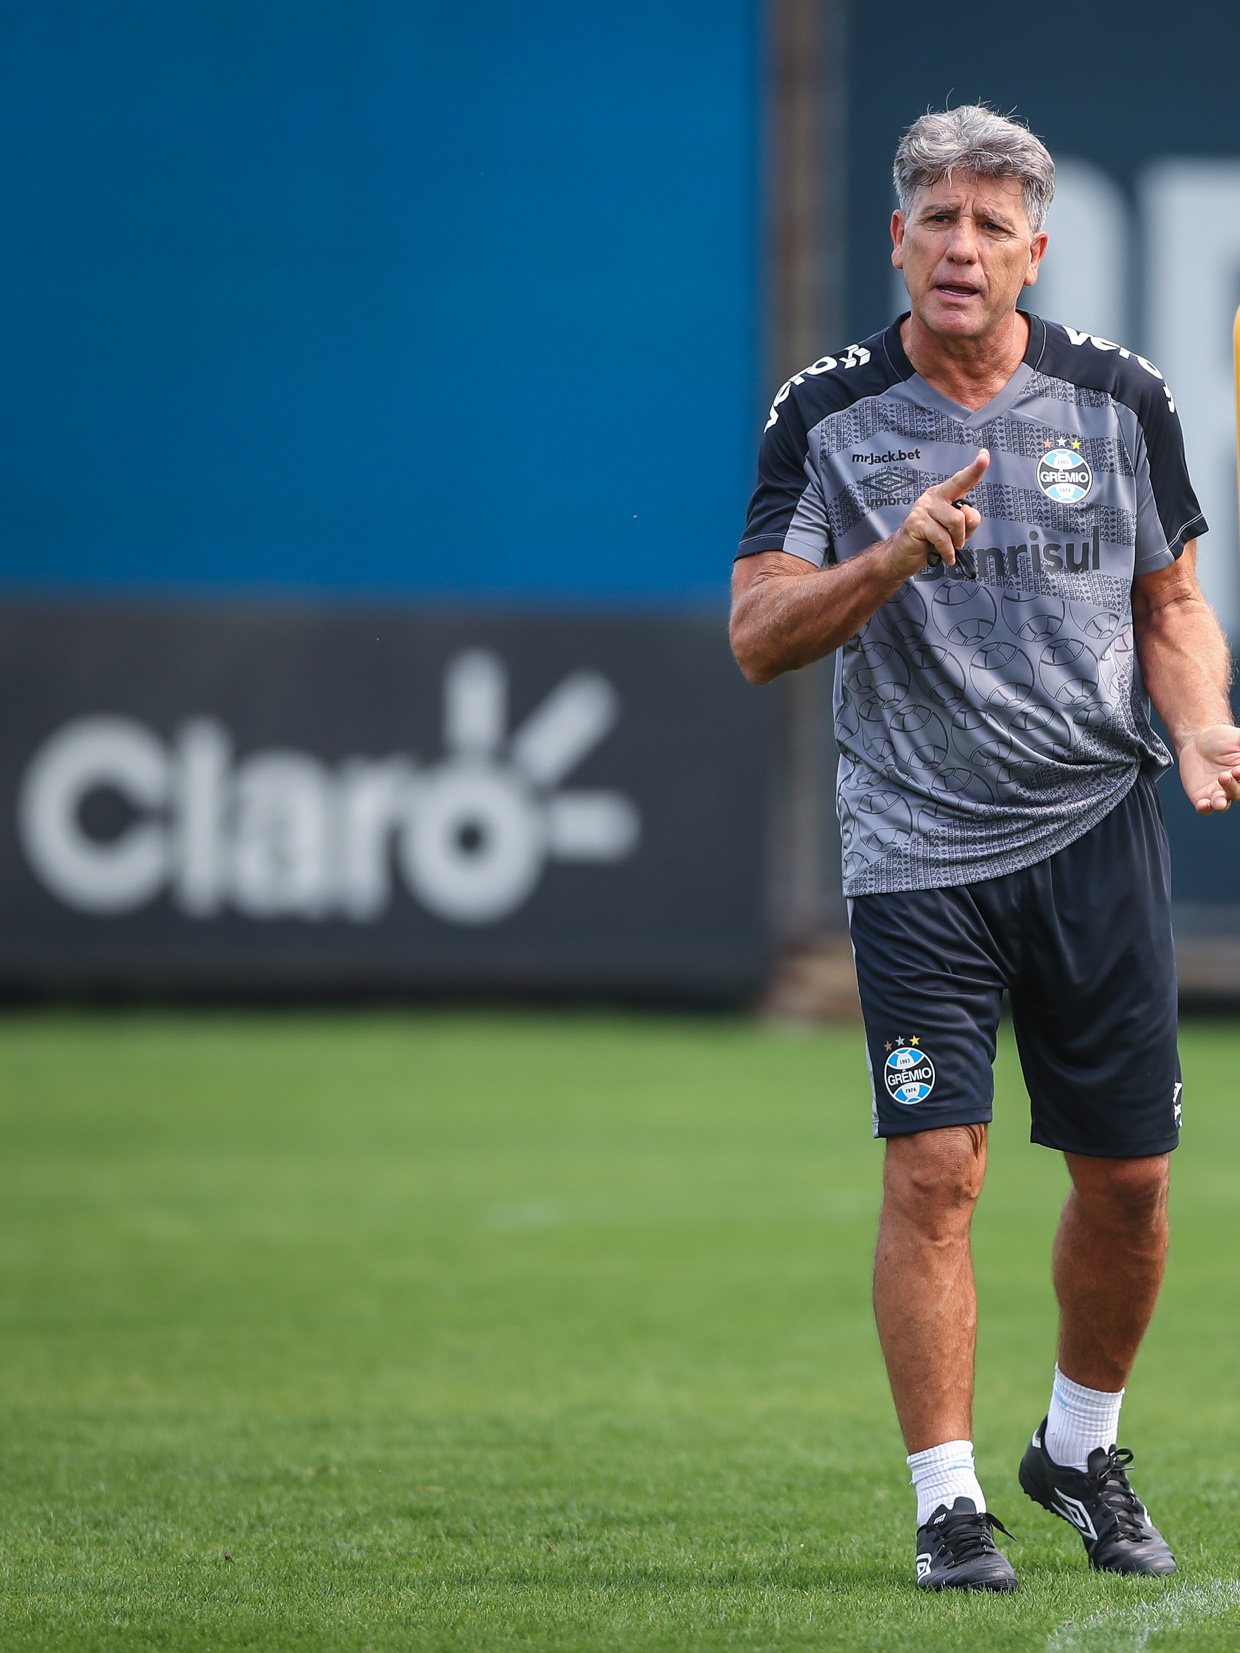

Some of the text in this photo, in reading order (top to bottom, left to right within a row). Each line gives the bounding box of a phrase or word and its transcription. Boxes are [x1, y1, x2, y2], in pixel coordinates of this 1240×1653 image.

[851, 448, 921, 465] mrJack.bet
[1040, 469, 1089, 483] GRÊMIO
[20, 714, 546, 922] Claro
[887, 1067, 932, 1086] GRÊMIO
